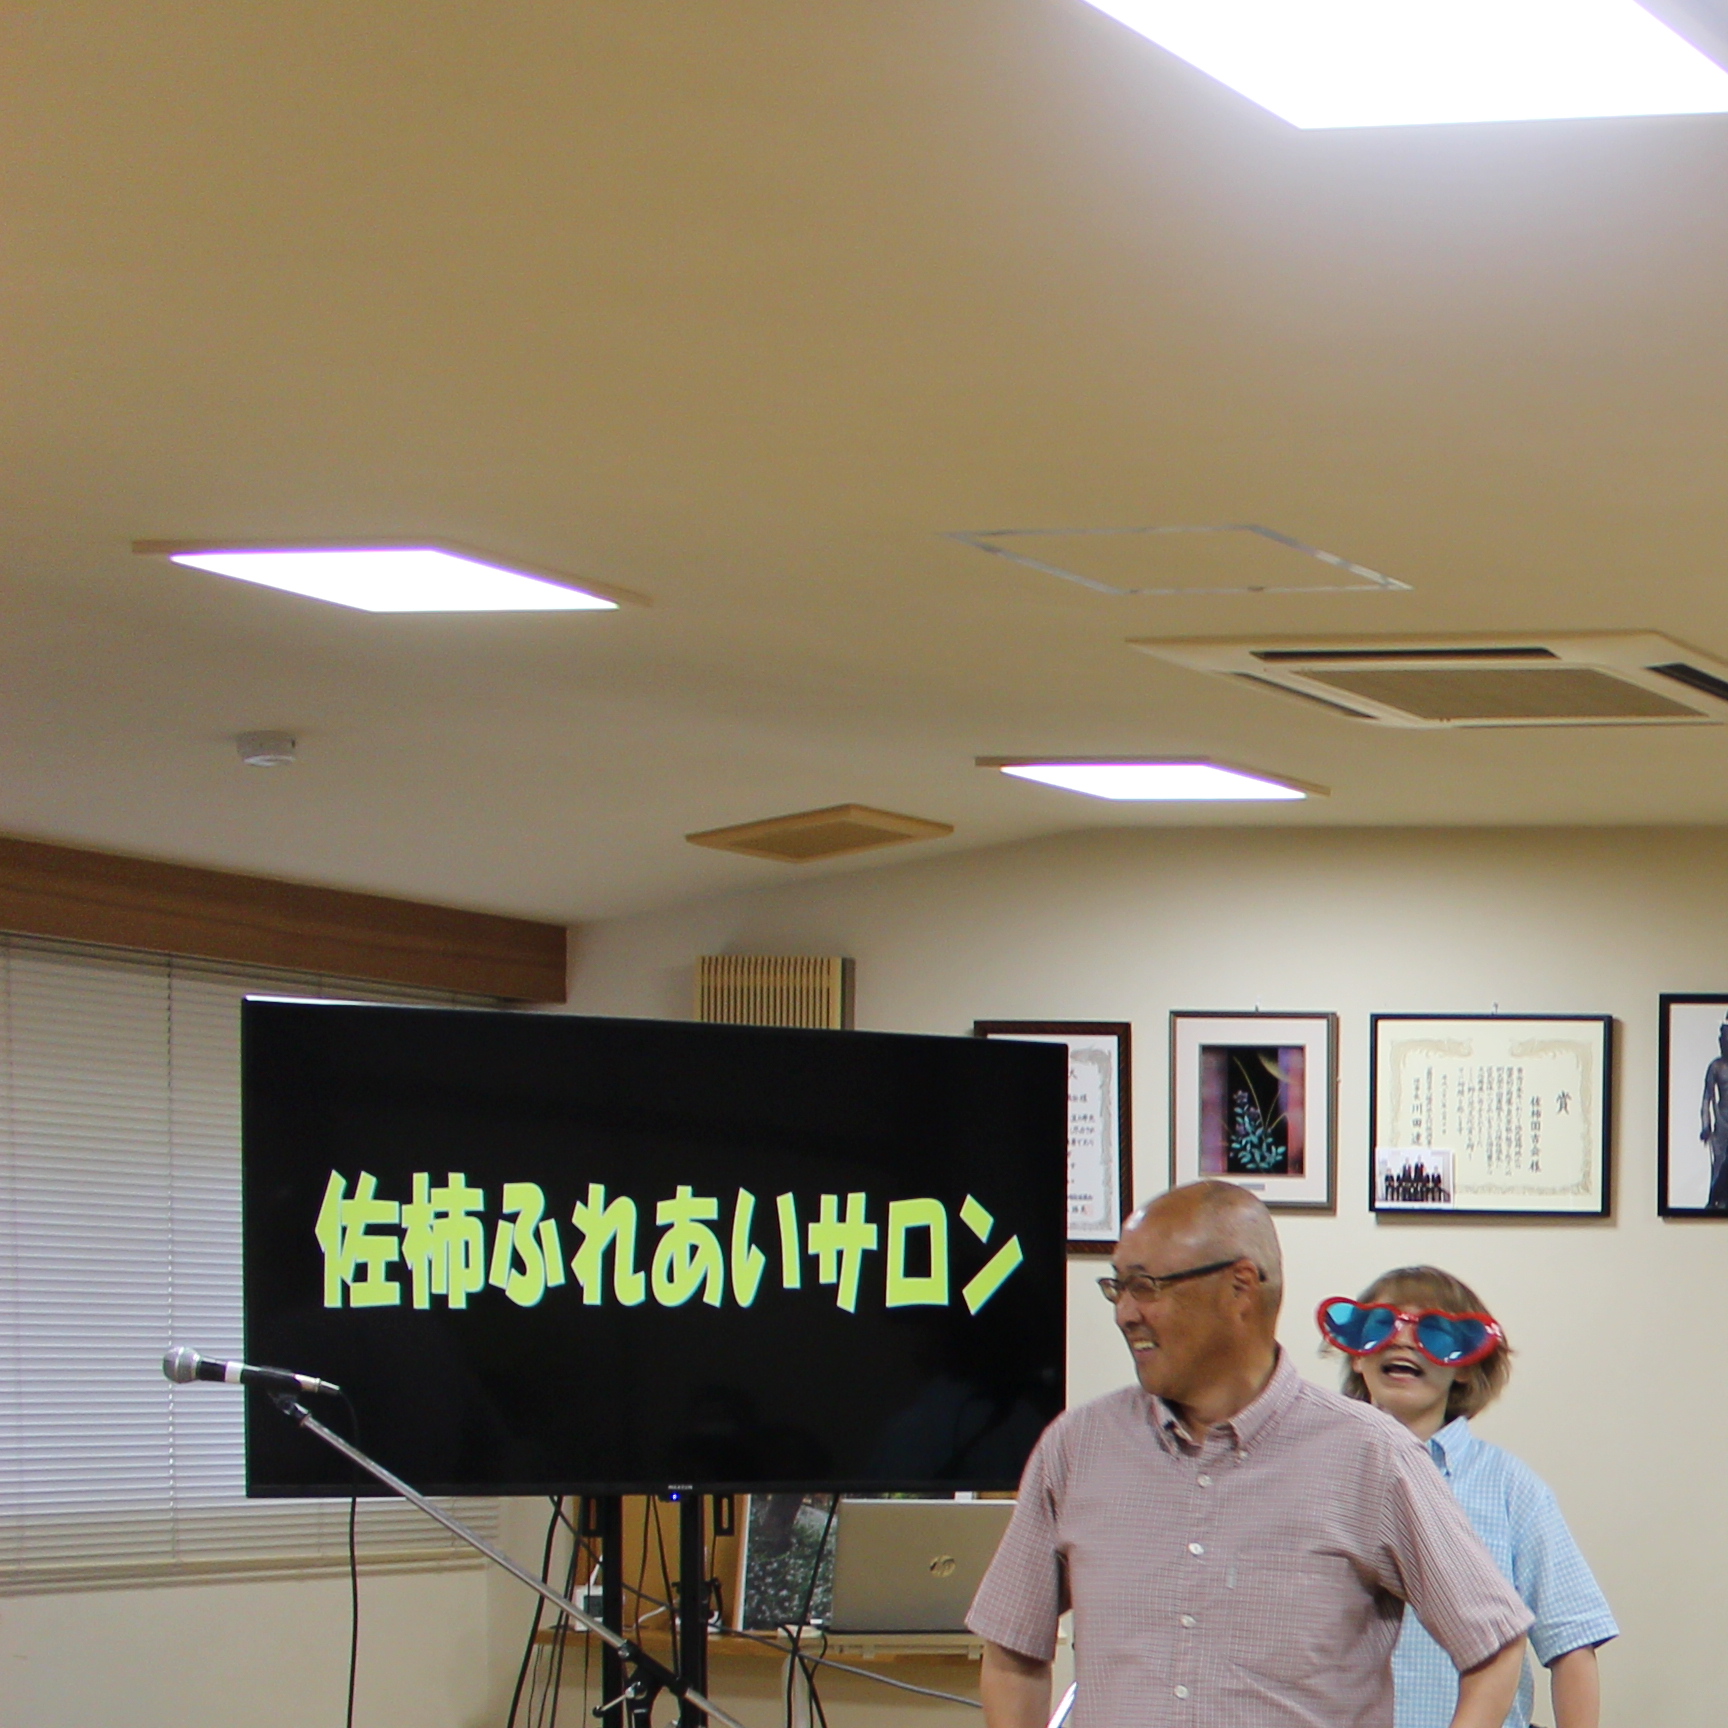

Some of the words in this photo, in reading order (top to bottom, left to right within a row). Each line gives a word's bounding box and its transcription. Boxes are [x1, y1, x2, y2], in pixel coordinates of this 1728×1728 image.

[314, 1168, 1024, 1315] 佐柿ふれあいサロン
